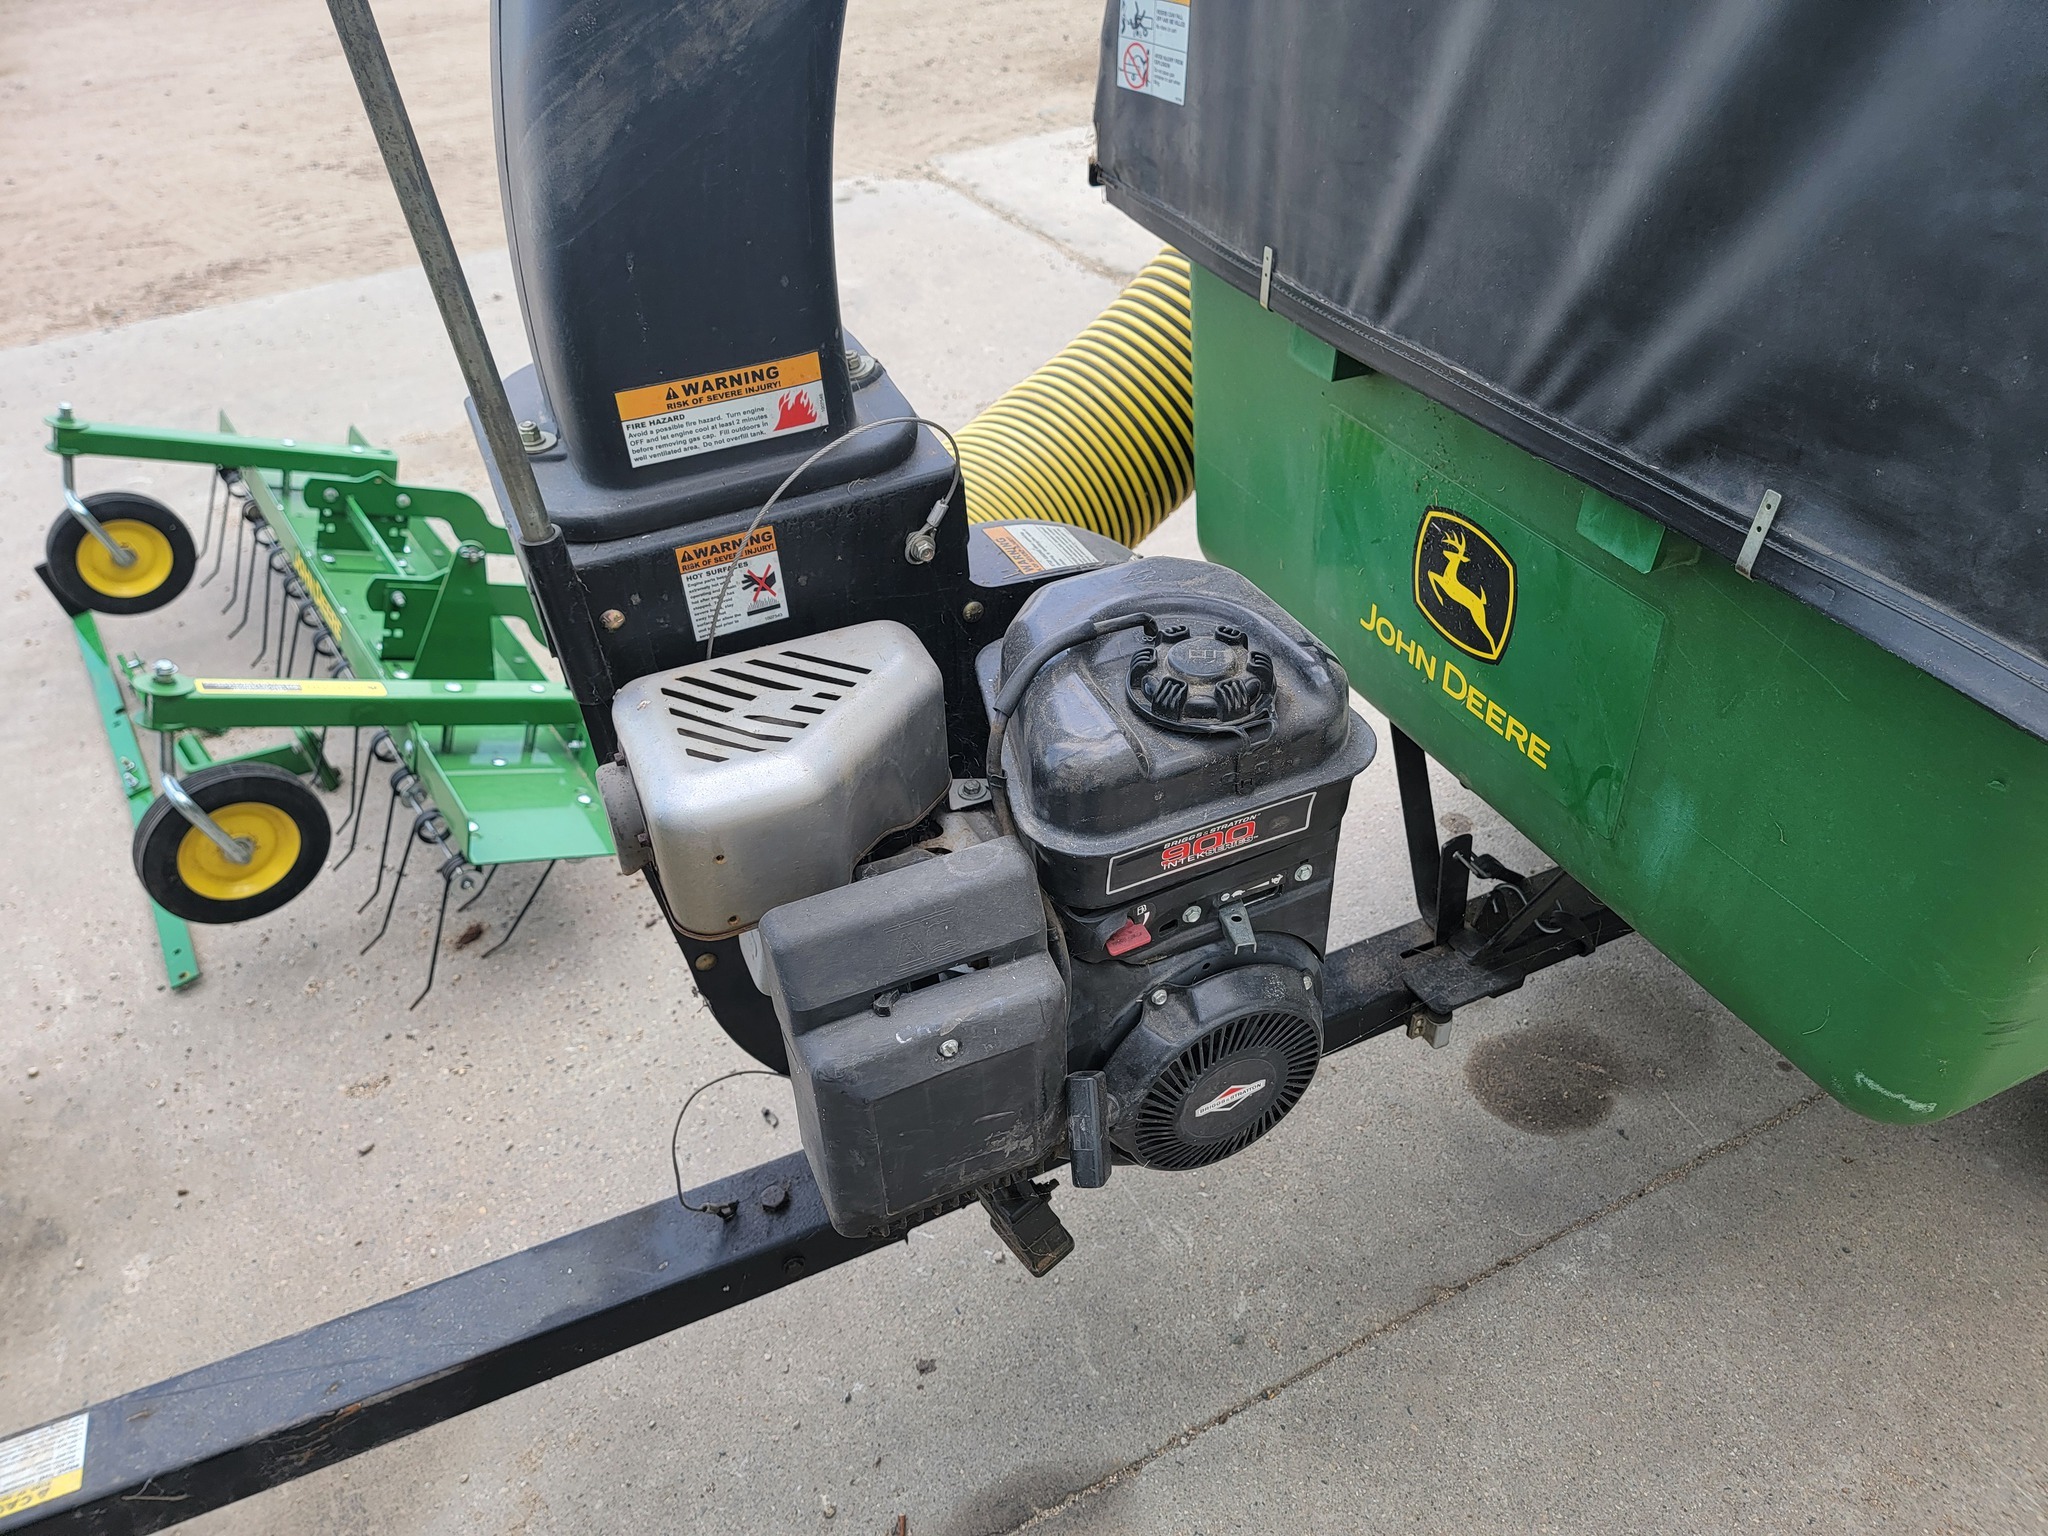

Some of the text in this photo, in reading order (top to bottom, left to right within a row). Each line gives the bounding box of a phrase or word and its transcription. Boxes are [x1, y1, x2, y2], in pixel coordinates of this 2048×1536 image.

[666, 380, 782, 410] RISK OF SEVERE INJURY!
[682, 365, 780, 397] WARNING
[626, 413, 685, 431] FIRE HAZARD
[628, 430, 648, 439] Avoid
[655, 422, 684, 434] possible
[698, 414, 723, 424] hazard.
[726, 410, 741, 418] Turn
[742, 406, 765, 416] engine
[630, 439, 644, 447] OFF
[646, 436, 659, 444] and
[670, 429, 694, 440] engine
[719, 420, 735, 428] least
[741, 413, 768, 423] minutes
[632, 445, 654, 454] before
[655, 438, 687, 451] removing
[731, 422, 761, 434] outdoors
[634, 454, 648, 462] well
[649, 447, 682, 459] ventilated
[683, 444, 700, 452] area.
[726, 433, 749, 443] overfill
[750, 429, 767, 438] tank.
[682, 562, 700, 571] RISK
[702, 558, 712, 566] OF
[744, 543, 774, 556] INJURY!
[993, 537, 1036, 573] WARNING
[686, 561, 749, 582] HOT SURFAES
[1360, 603, 1551, 770] JOHN DEERE
[1161, 821, 1256, 867] 900
[1164, 832, 1202, 849] BRIGGS
[1199, 1099, 1226, 1114] BRIGGS
[1230, 1082, 1262, 1101] STRATTON
